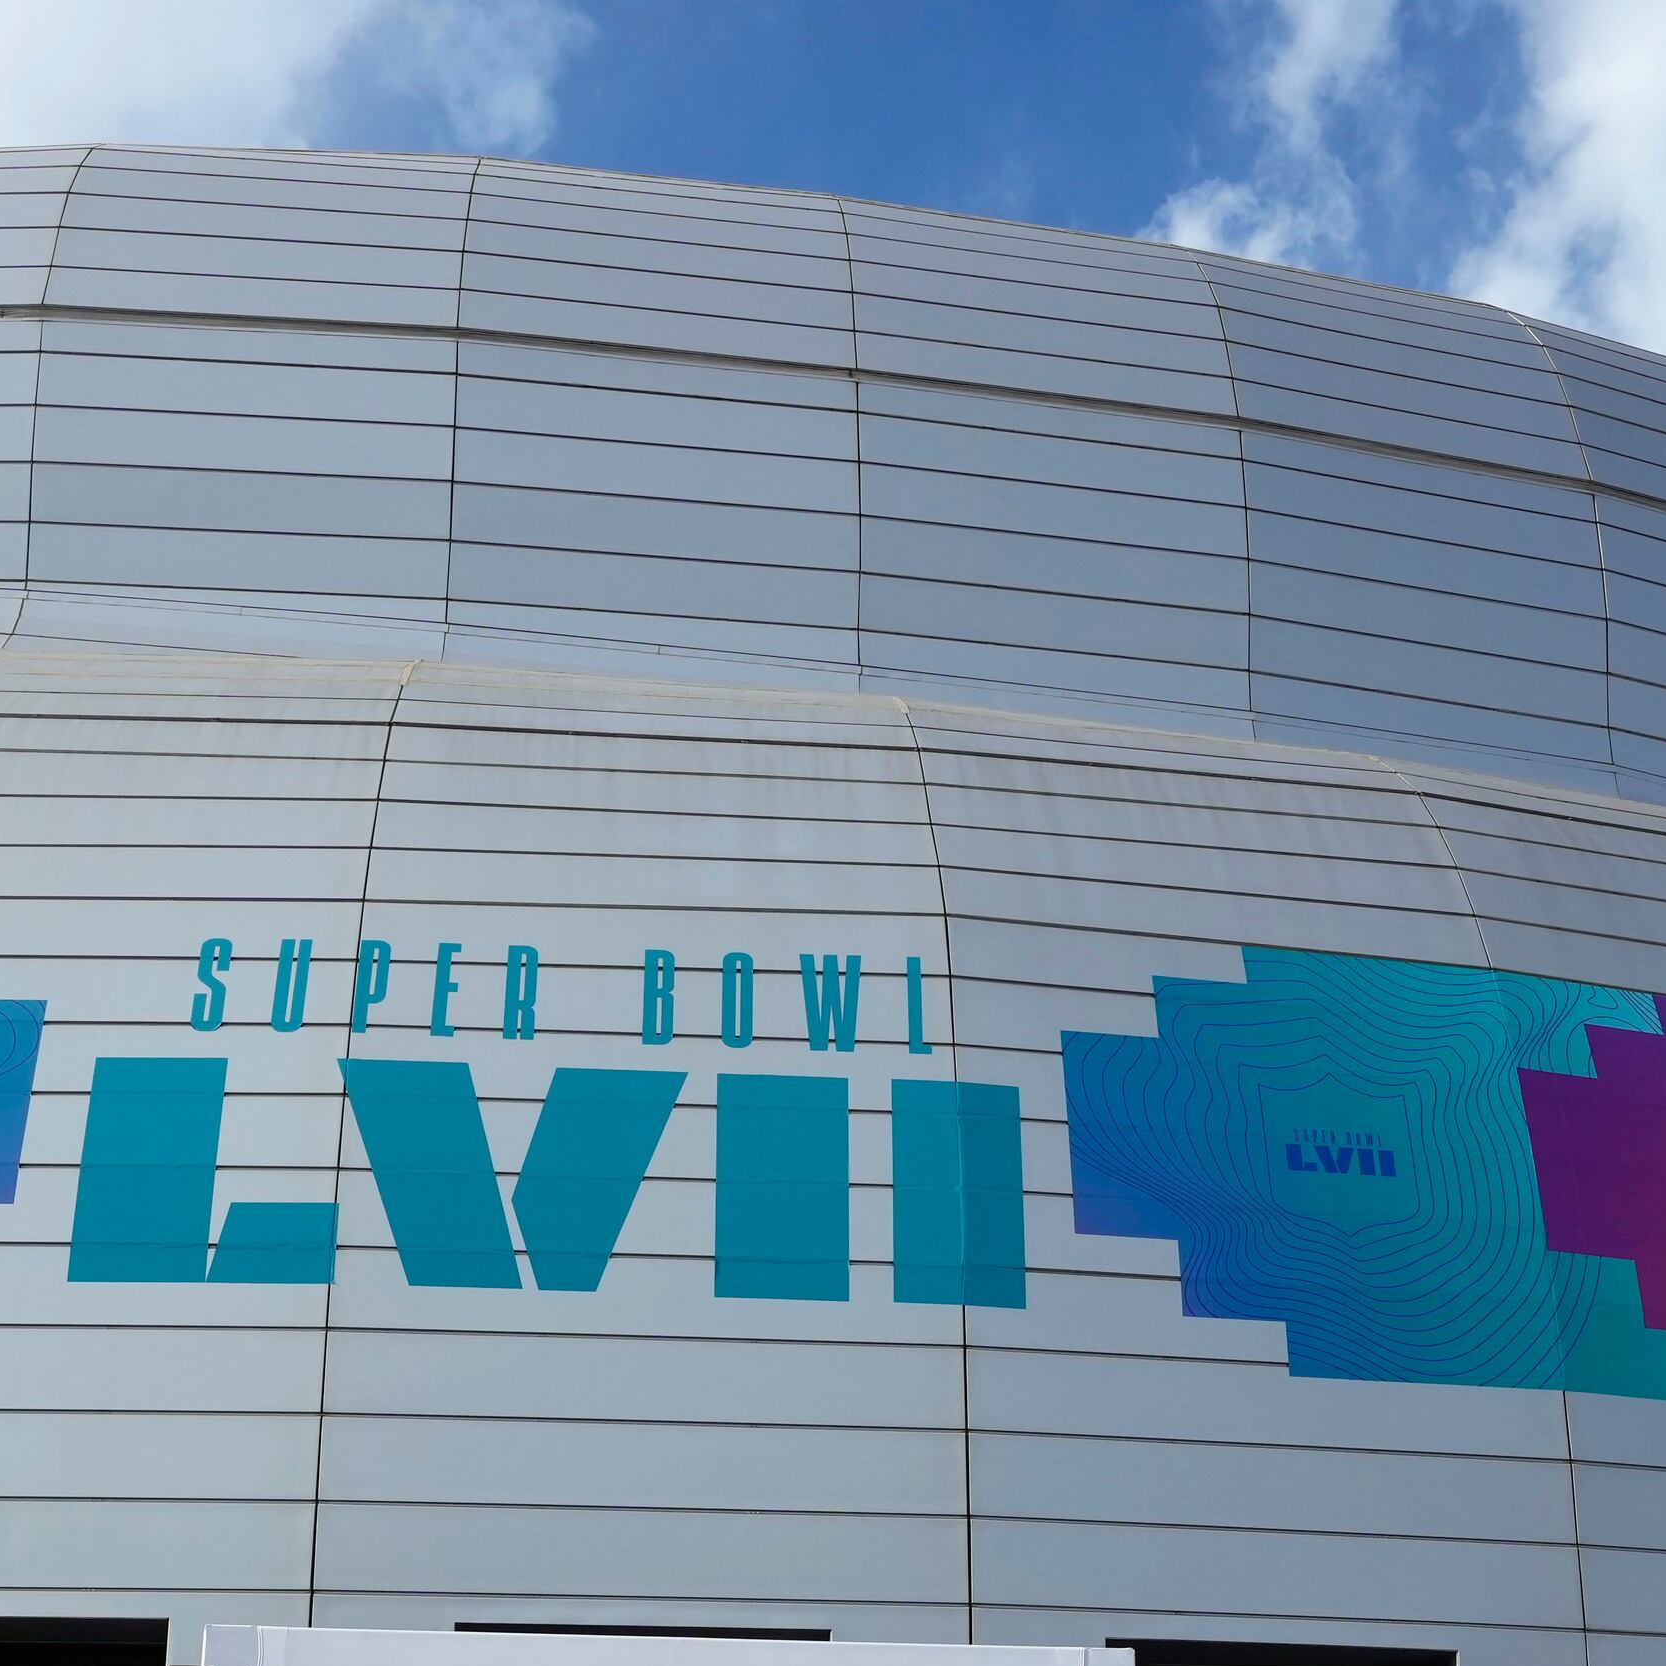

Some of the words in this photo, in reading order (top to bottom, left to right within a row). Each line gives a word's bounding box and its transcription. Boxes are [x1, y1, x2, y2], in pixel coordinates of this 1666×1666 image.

[190, 938, 539, 1040] SUPER
[641, 949, 933, 1054] BOWL
[66, 1057, 1027, 1310] LVII
[1285, 1143, 1397, 1178] LVII
